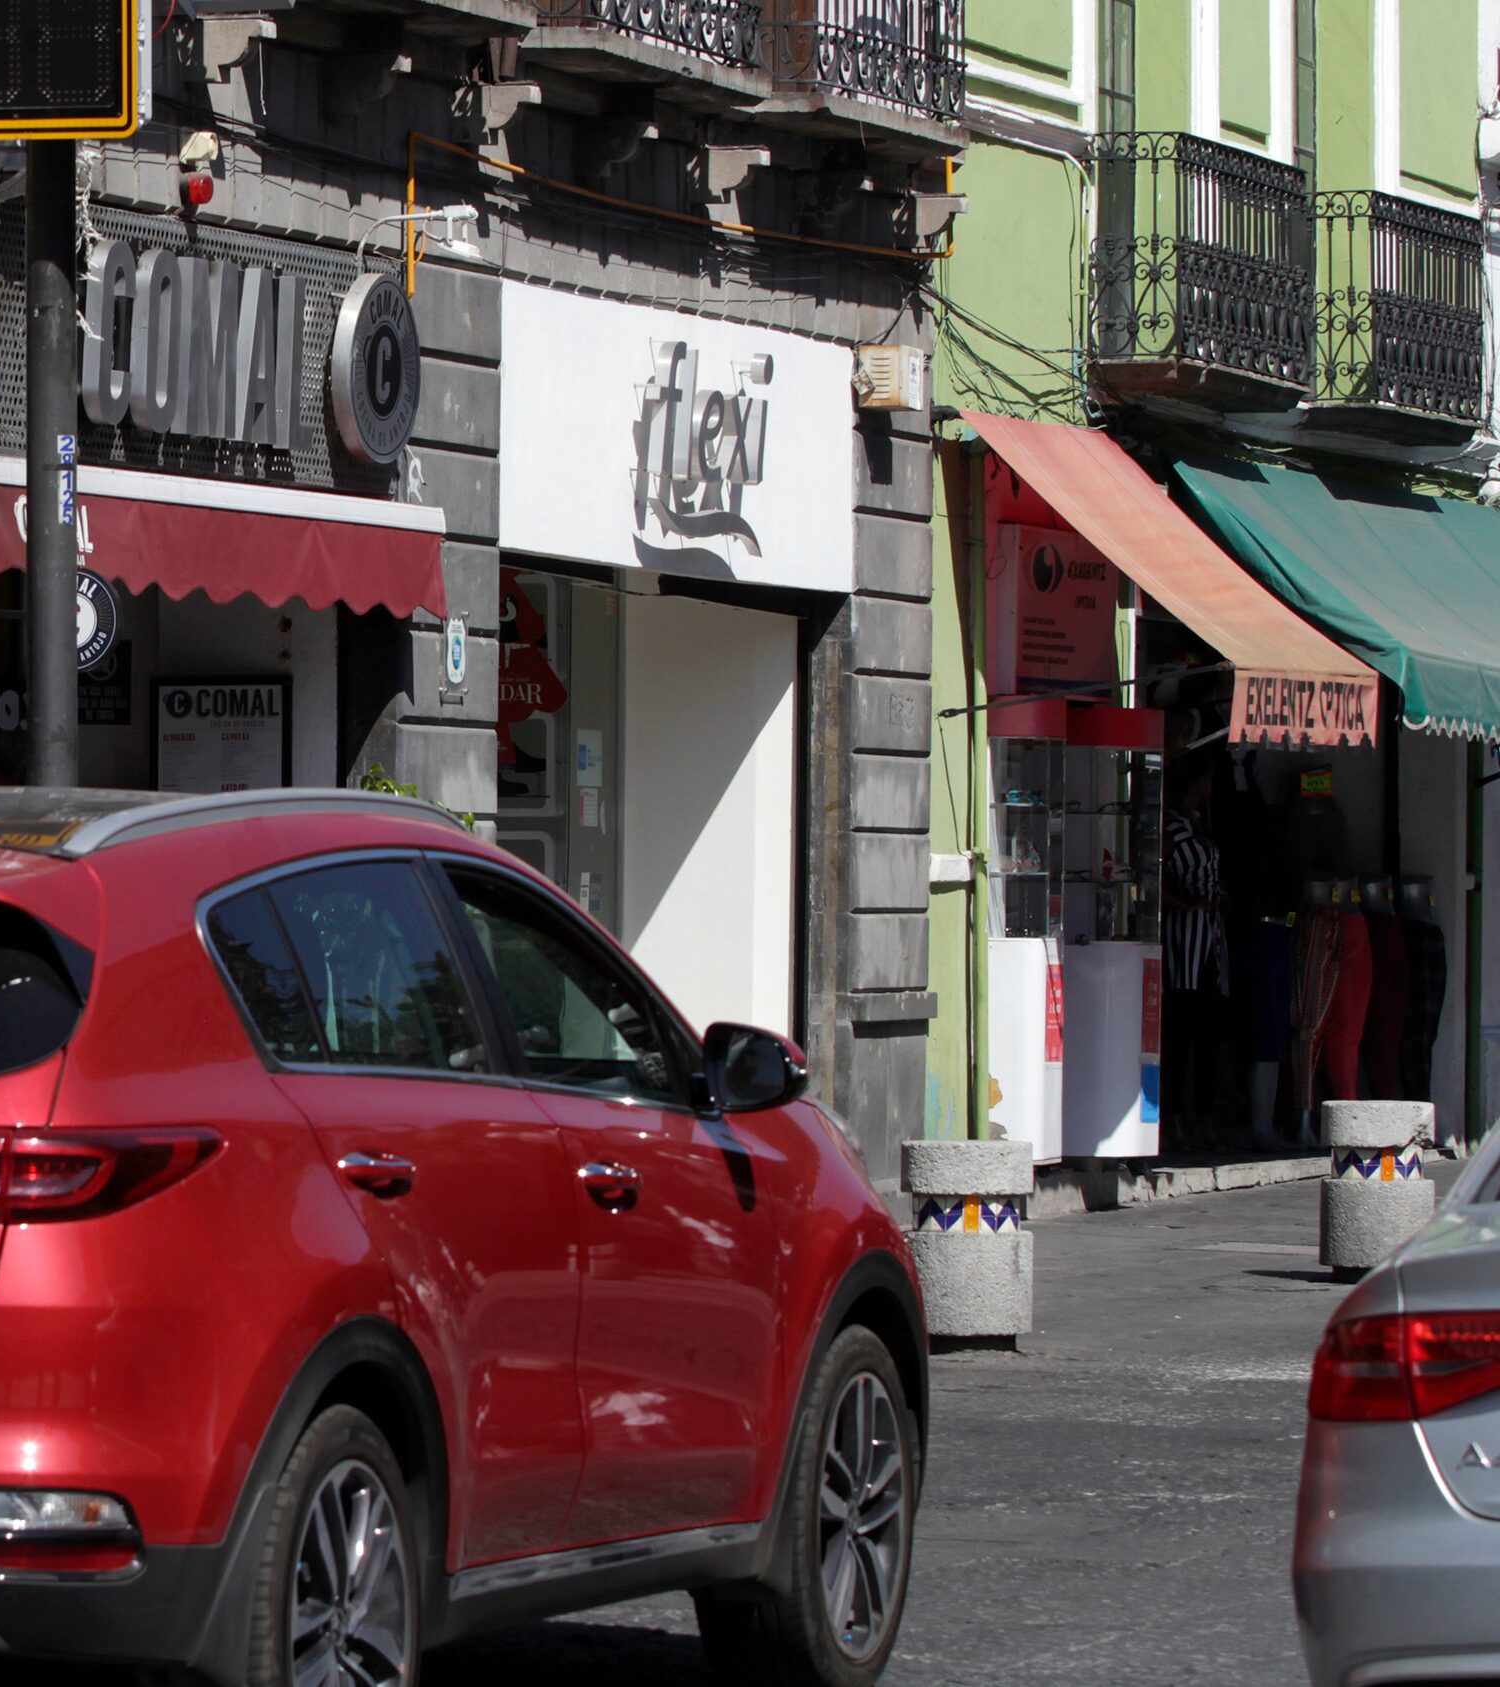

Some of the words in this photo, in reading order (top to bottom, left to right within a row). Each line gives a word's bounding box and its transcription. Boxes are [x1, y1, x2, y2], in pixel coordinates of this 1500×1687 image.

[370, 289, 405, 330] COMAL
[82, 239, 315, 450] COMAL
[647, 340, 774, 486] flexi
[79, 631, 108, 662] ANTOJO
[196, 688, 280, 717] COMAL
[1245, 676, 1315, 728] EXELENTZ
[1454, 1440, 1500, 1471] A
